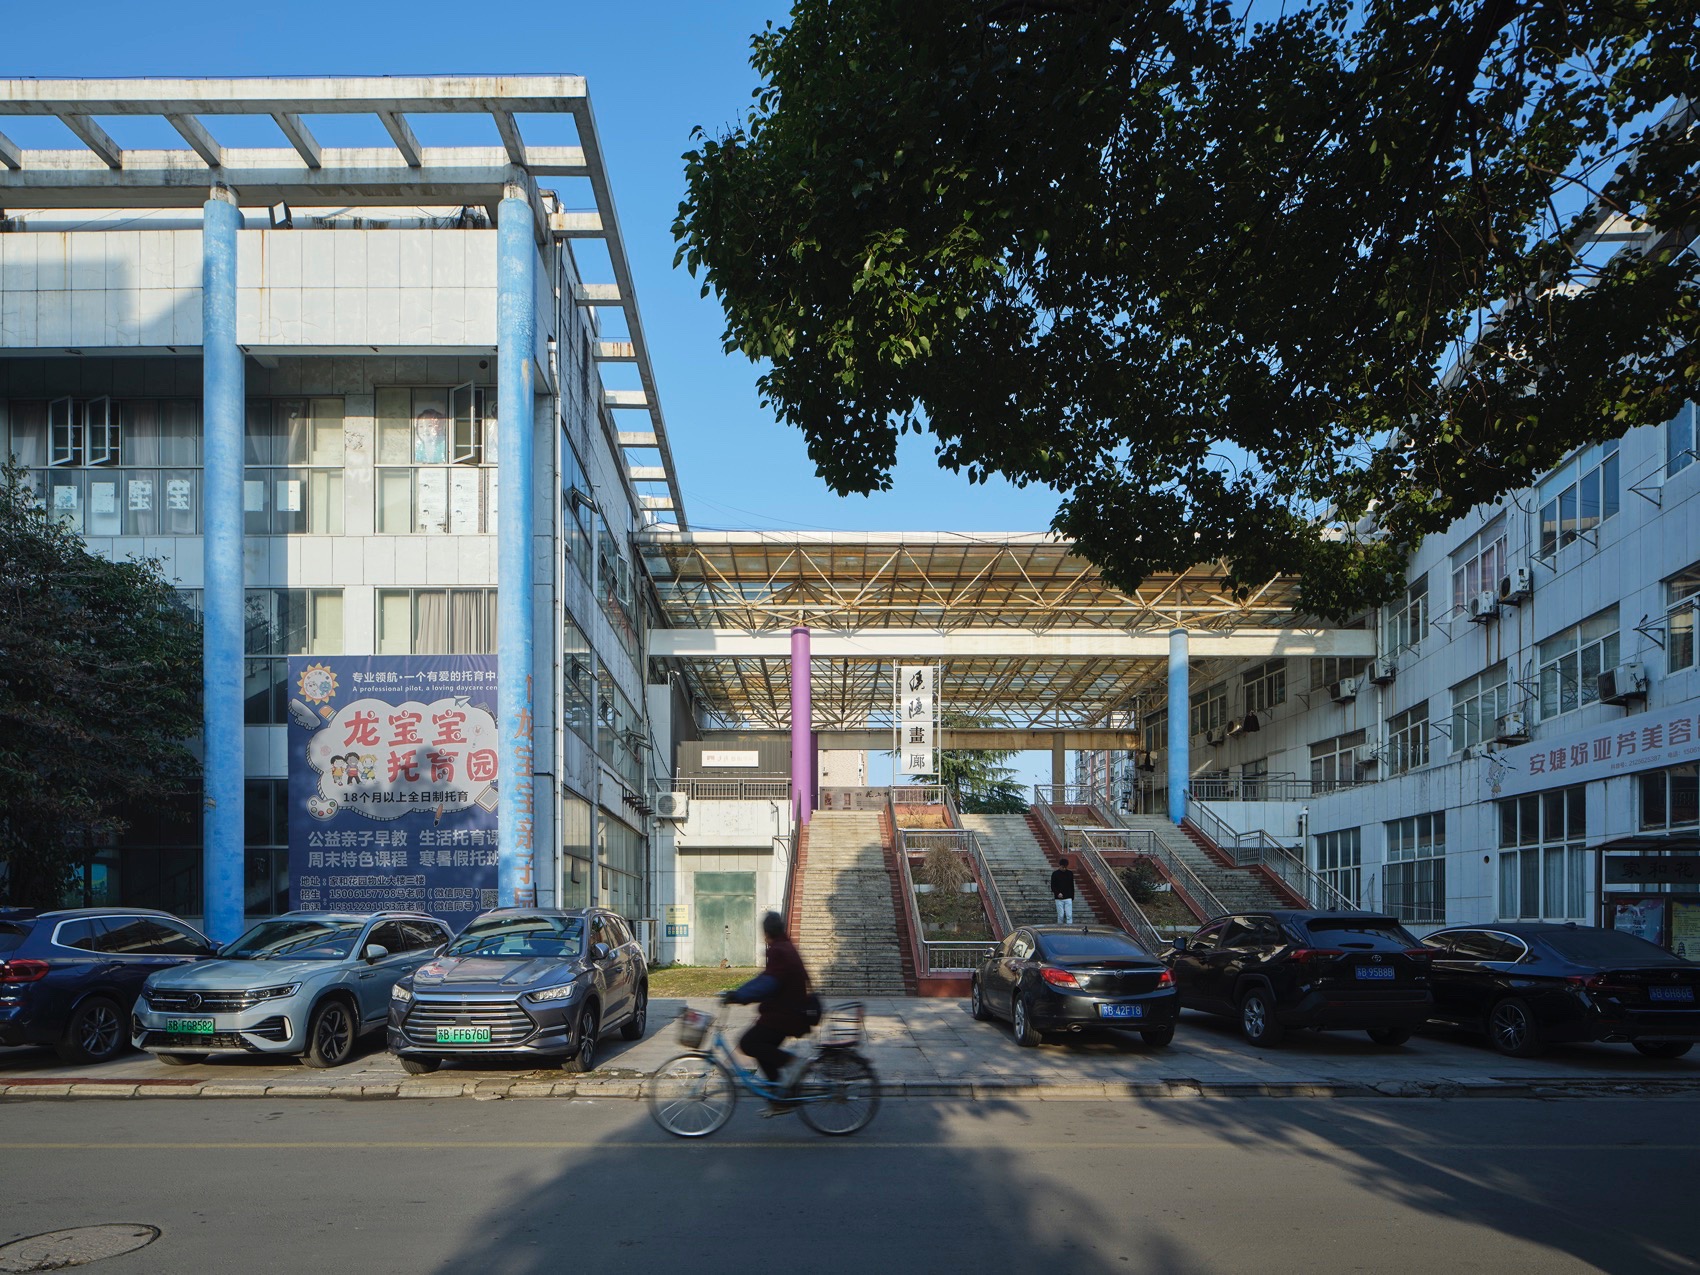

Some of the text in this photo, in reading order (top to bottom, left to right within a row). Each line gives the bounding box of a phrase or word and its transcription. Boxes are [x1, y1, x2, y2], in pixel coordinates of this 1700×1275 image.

[352, 670, 498, 683] 专业领航·一个有爱的托育中
[360, 685, 403, 693] professional
[405, 685, 424, 693] pilot,
[456, 684, 484, 692] daycare
[343, 709, 468, 748] 龙宝宝
[1530, 714, 1700, 776] 安婕妤亚芳美容
[387, 748, 498, 783] 托育园
[343, 790, 469, 804] 18个月以上全日制托育
[308, 829, 498, 847] 公益亲子早教 生活托育课
[308, 850, 498, 868] 周末特色课程 寒暑假托班
